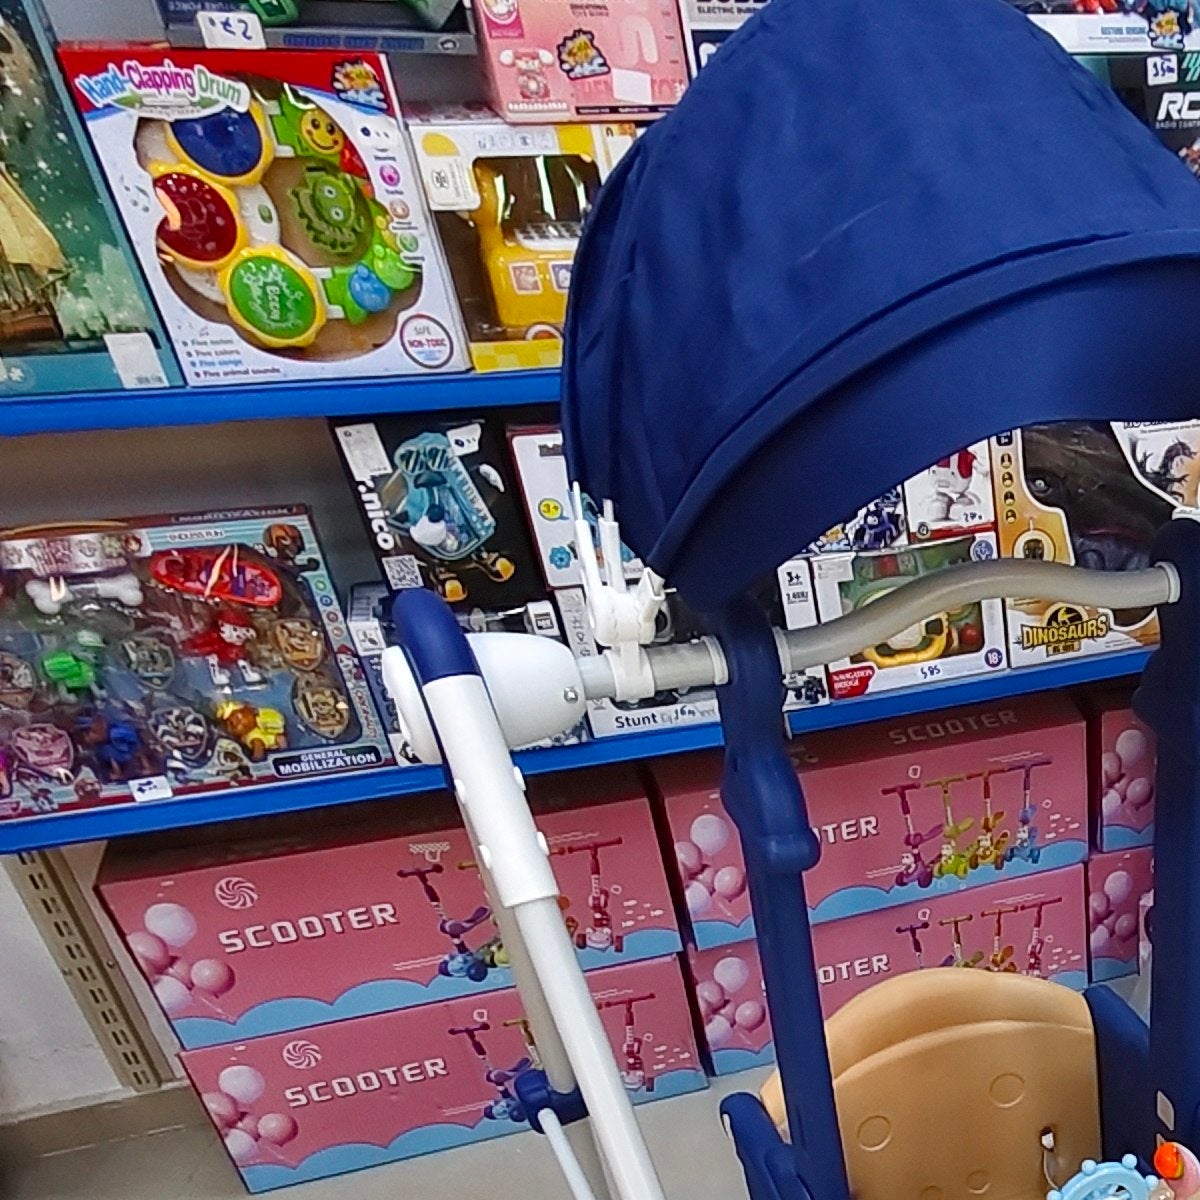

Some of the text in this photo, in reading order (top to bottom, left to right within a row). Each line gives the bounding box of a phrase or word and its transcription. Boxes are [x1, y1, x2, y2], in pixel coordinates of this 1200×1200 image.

[196, 67, 242, 105] Drum
[1022, 614, 1108, 649] DINOSAURS
[831, 668, 874, 682] NAVIGATION
[615, 712, 658, 729] Stunt
[888, 710, 1018, 745] SCOOTER
[279, 752, 377, 775] MOBILIZATION
[301, 750, 346, 762] GENERAL
[218, 903, 400, 953] SCOOTER
[284, 1057, 449, 1107] SCOOTER
